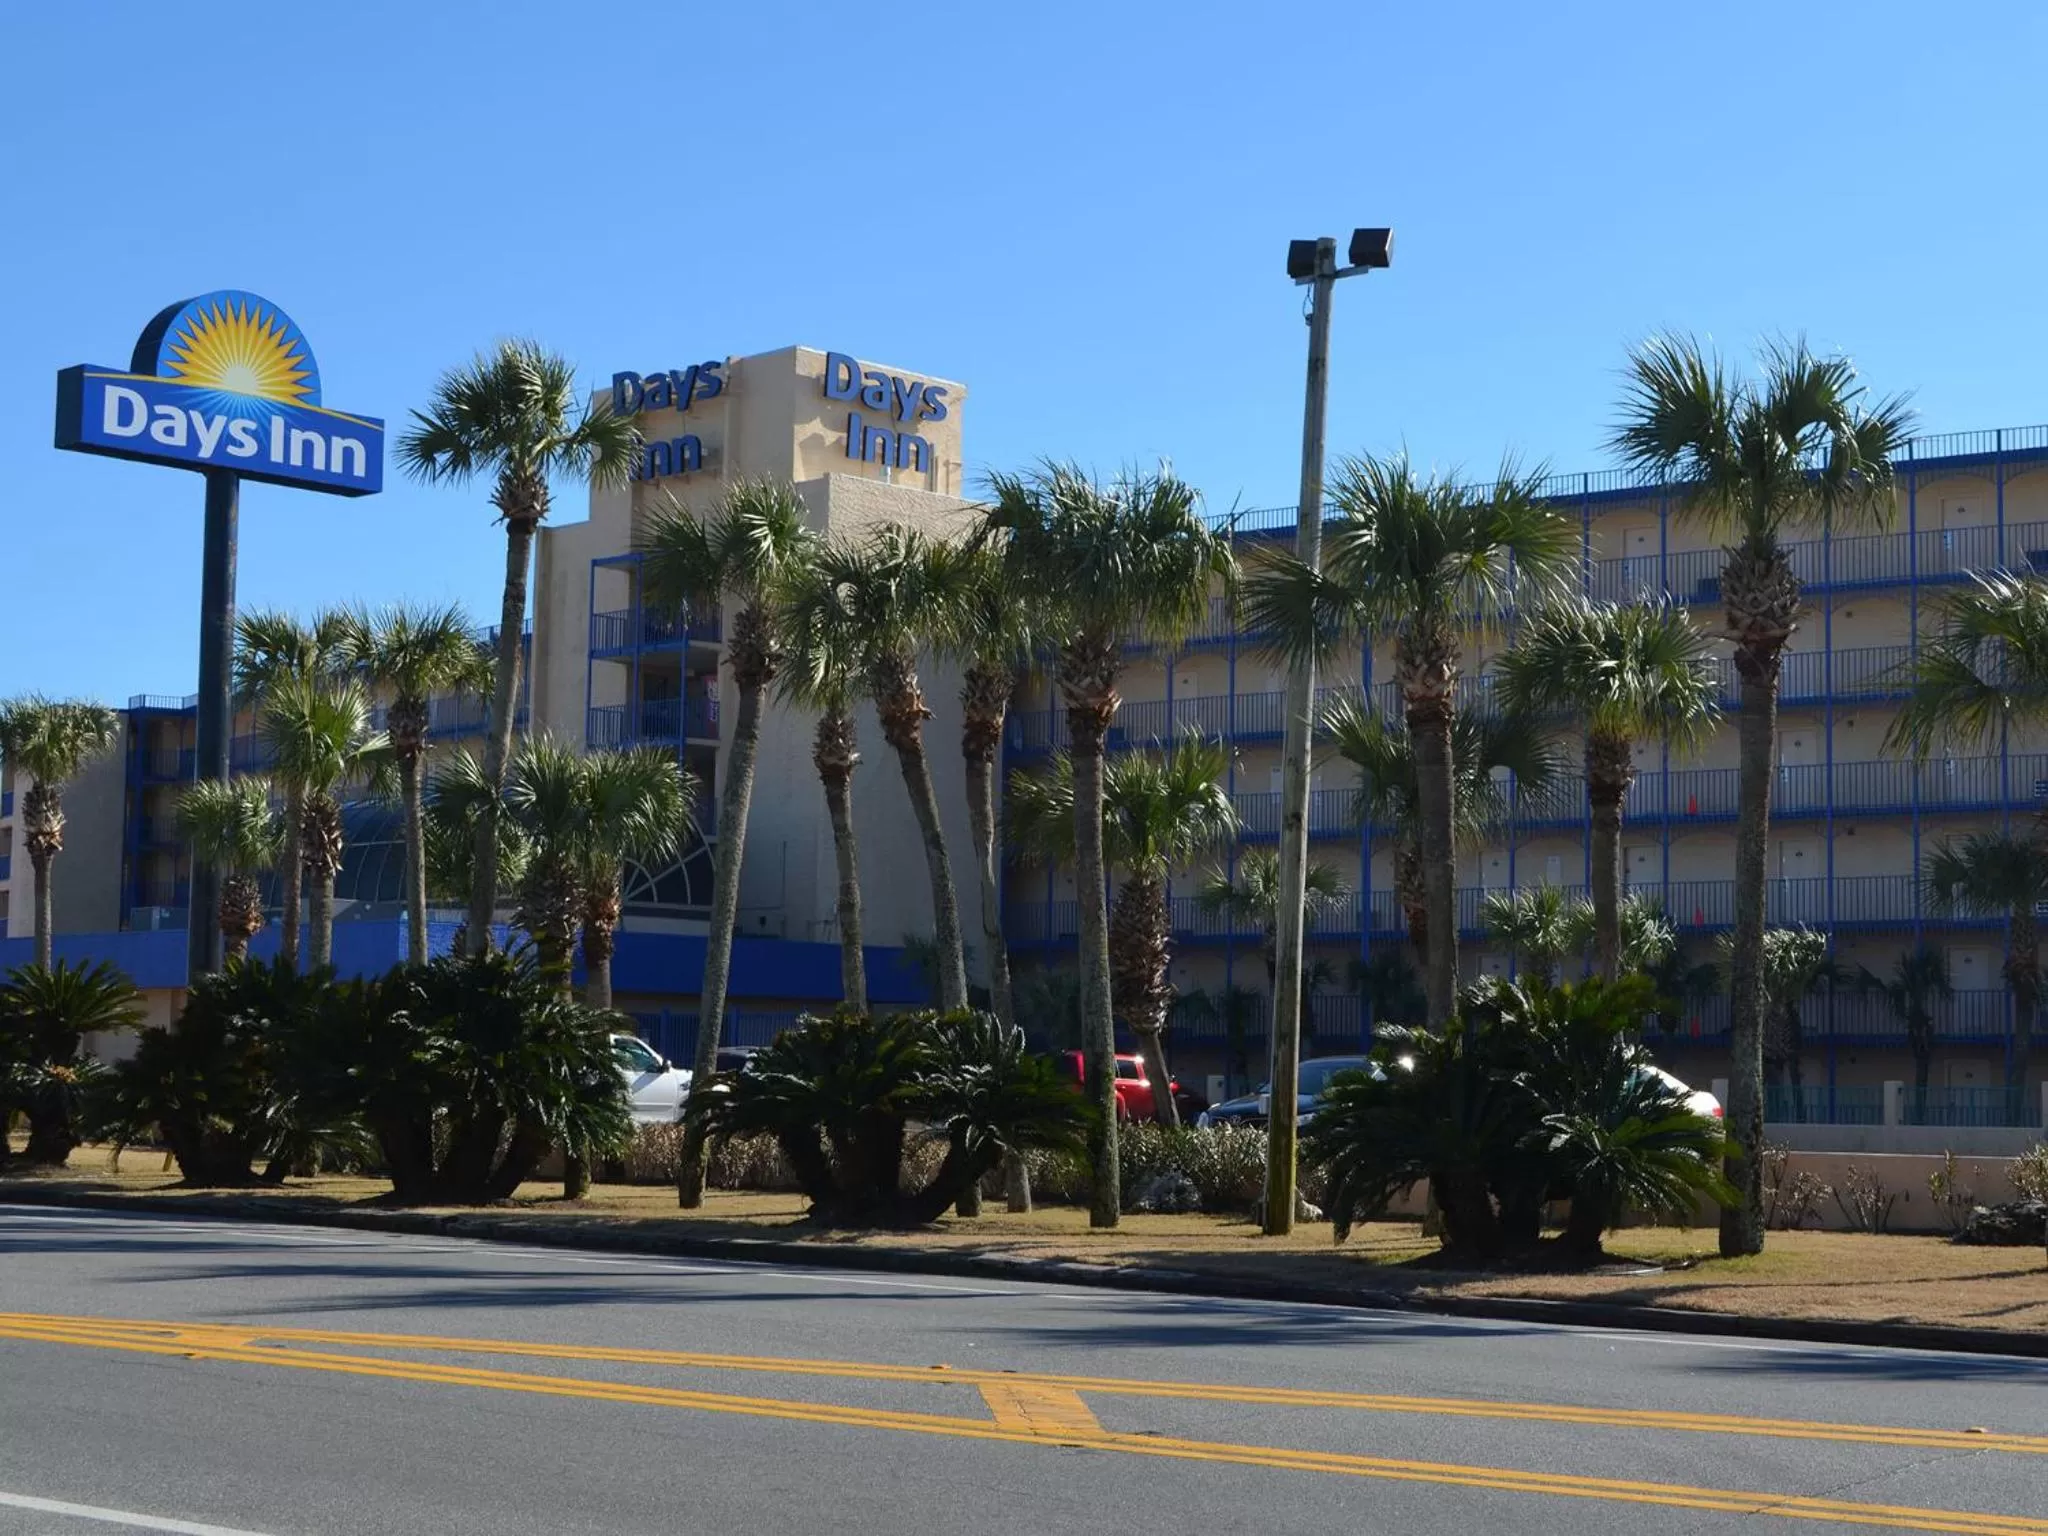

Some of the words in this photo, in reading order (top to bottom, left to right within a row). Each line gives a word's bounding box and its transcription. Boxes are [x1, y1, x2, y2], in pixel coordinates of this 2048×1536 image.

[612, 360, 721, 416] Days
[824, 352, 947, 421] Days
[103, 384, 258, 458] Days
[270, 415, 366, 477] Inn
[846, 412, 929, 473] Inn
